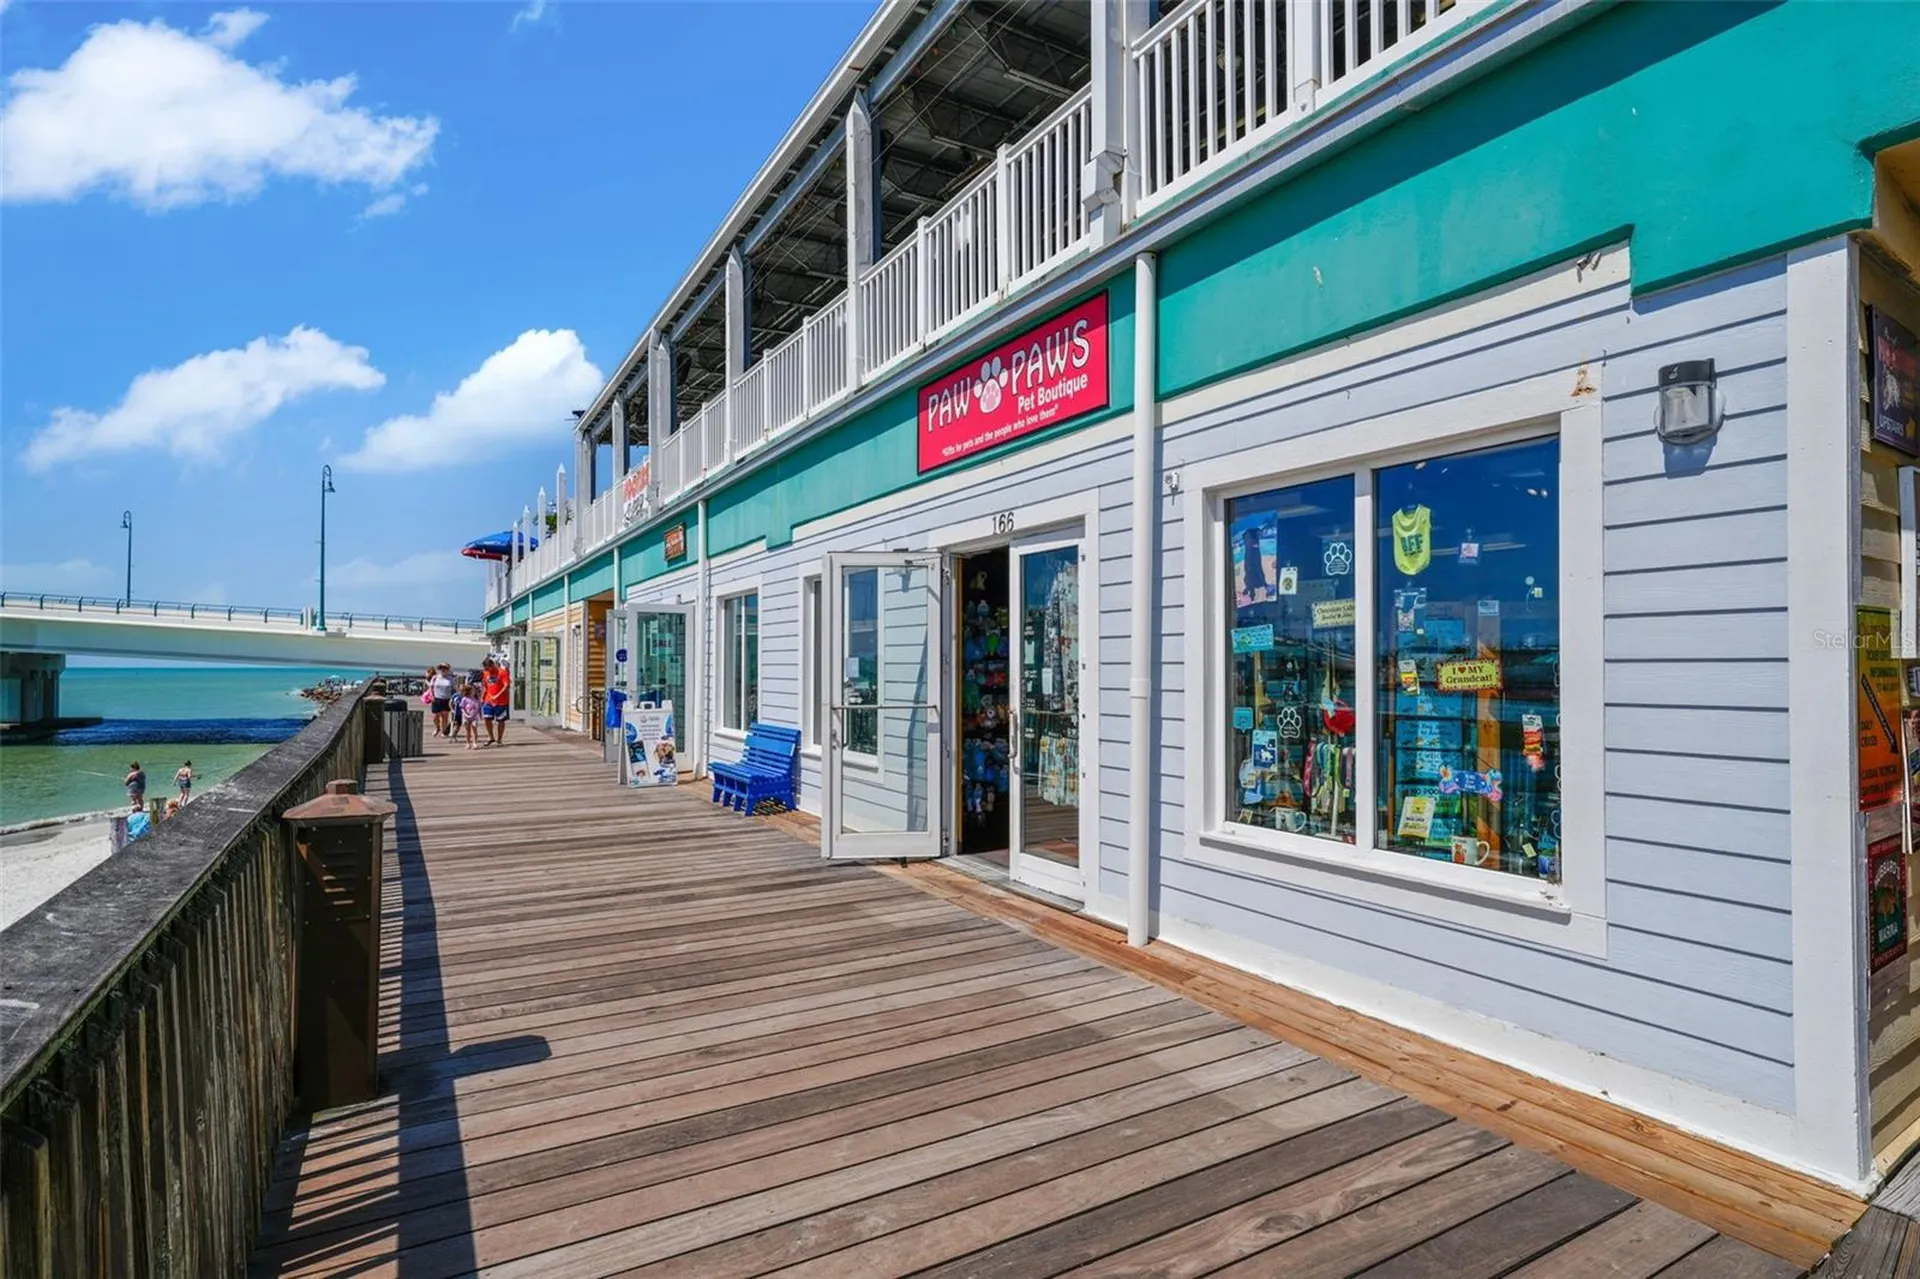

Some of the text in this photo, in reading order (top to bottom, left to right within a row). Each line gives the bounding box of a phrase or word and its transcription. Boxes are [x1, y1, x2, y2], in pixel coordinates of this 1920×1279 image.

[928, 318, 1091, 432] PAW PAWS
[1017, 373, 1088, 414] Pet Boutique
[974, 433, 984, 446] and
[984, 431, 994, 442] the
[994, 424, 1012, 438] people
[1013, 419, 1025, 430] who
[1026, 414, 1038, 427] love
[992, 511, 1014, 535] 166
[1446, 674, 1493, 684] Grandcat!
[1468, 665, 1484, 674] MY
